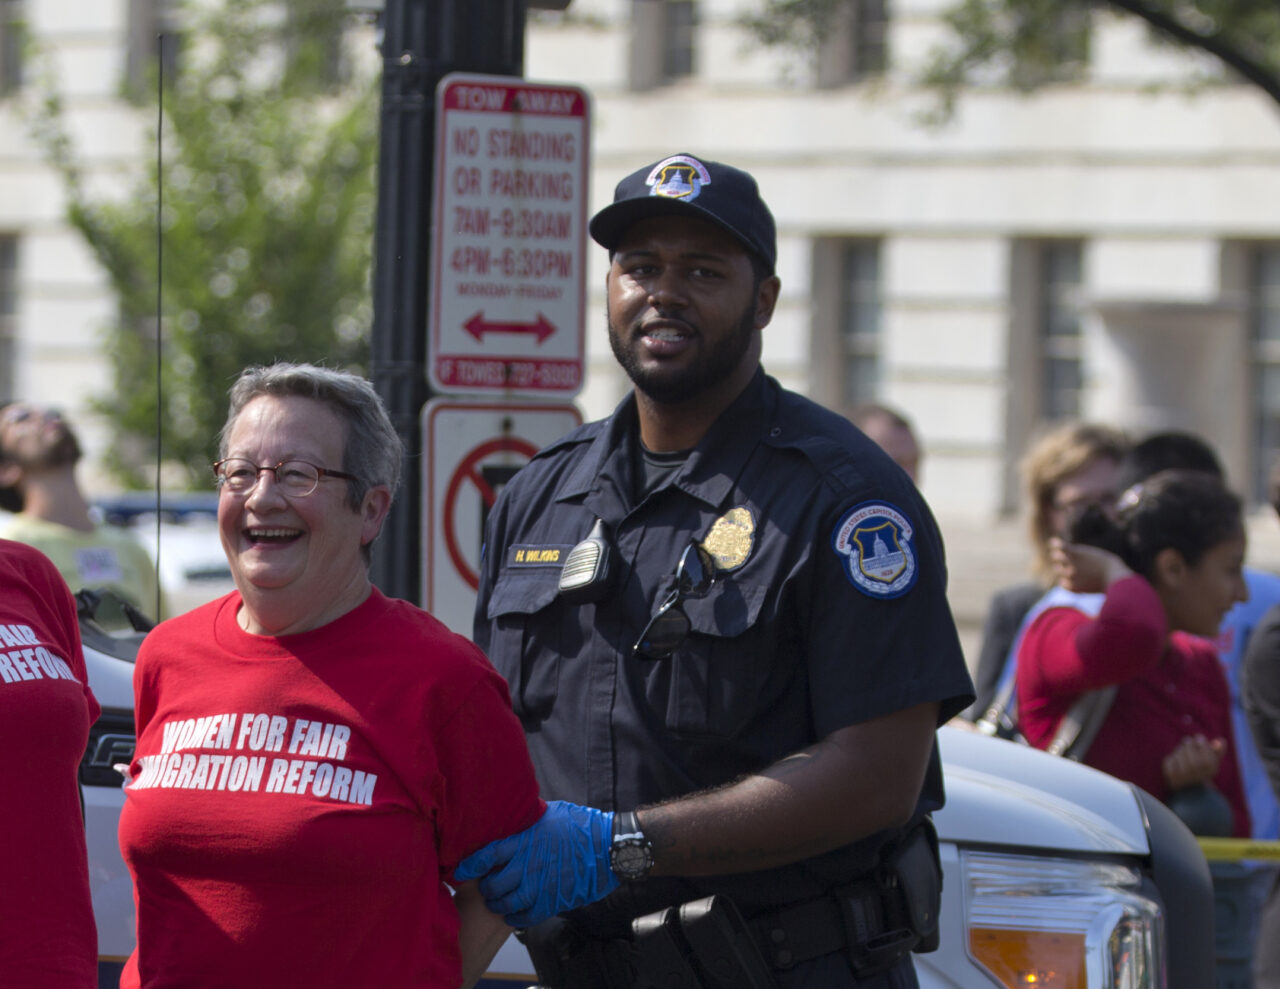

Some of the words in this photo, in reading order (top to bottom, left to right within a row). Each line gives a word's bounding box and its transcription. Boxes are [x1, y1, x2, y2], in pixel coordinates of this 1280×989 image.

[456, 87, 507, 110] TOW
[515, 89, 577, 113] AWAY
[453, 126, 479, 157] NO
[487, 128, 576, 163] STANDING
[453, 166, 481, 195] OR
[489, 168, 573, 202] PARKING
[160, 713, 237, 754] WOMEN
[235, 713, 288, 752] FOR
[287, 719, 352, 761] FAIR
[265, 758, 378, 806] REFORM
